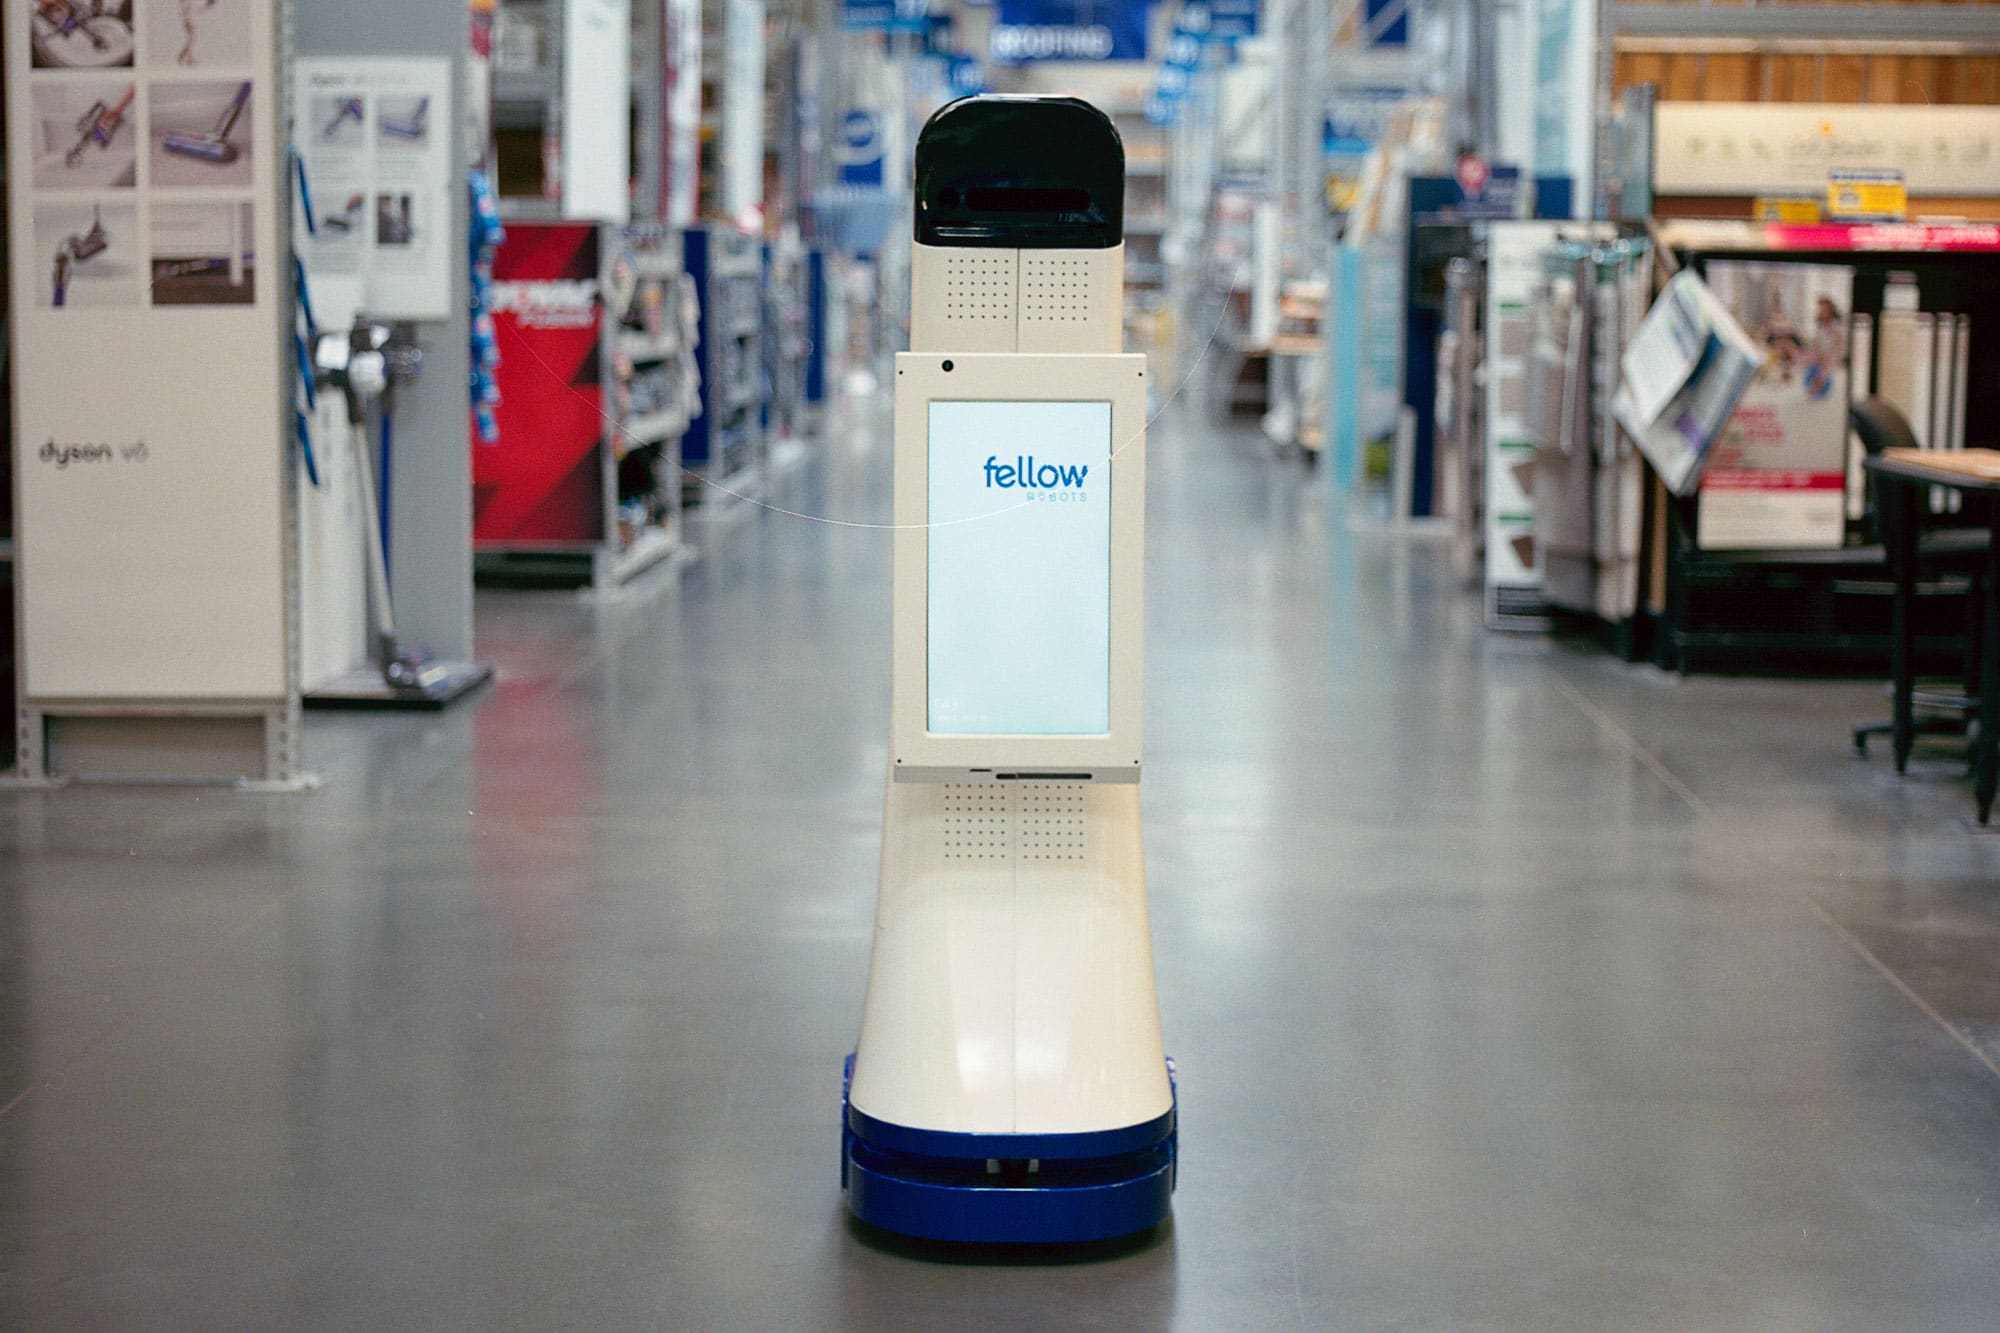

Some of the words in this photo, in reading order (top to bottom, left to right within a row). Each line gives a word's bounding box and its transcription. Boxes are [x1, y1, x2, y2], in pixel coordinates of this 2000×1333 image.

[39, 438, 112, 470] dyson
[983, 455, 1089, 488] fellow
[1026, 491, 1088, 502] ROBOTS
